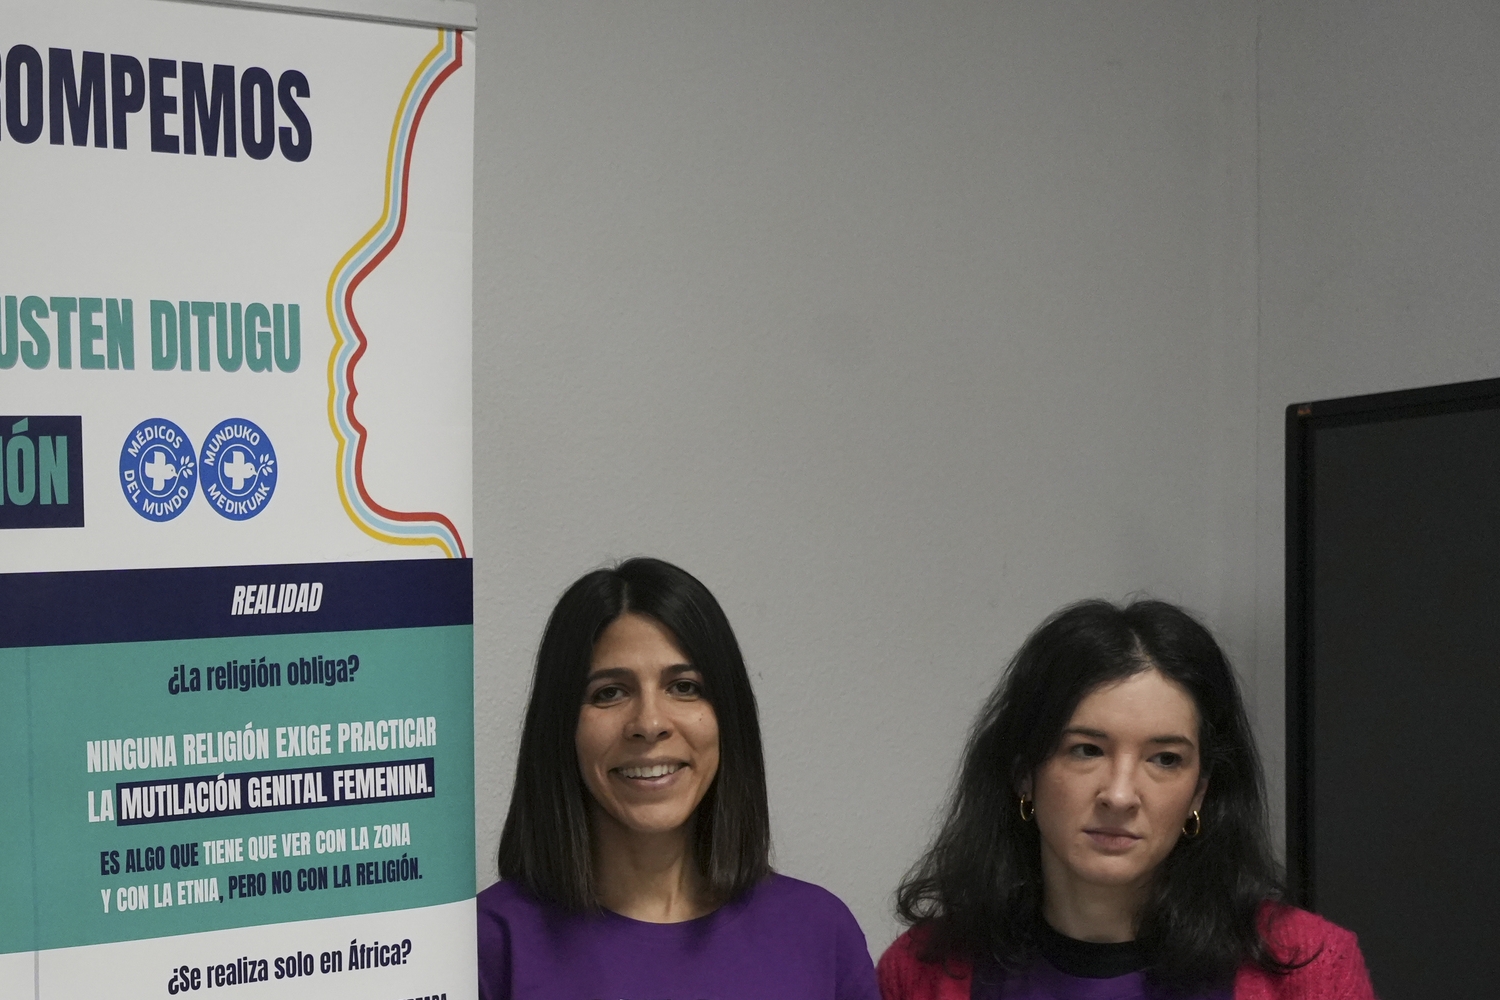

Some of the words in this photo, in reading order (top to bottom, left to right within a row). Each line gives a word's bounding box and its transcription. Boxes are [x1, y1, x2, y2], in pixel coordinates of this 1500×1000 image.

[150, 300, 301, 373] DITUGU
[128, 425, 182, 457] MÉDICOS
[204, 425, 260, 466] MUNDUKO
[124, 470, 142, 503] DEL
[143, 485, 188, 516] MUNDO
[208, 482, 270, 514] MEDIKUAK
[232, 583, 323, 616] REALIDAD
[168, 664, 200, 695] ¿La
[207, 657, 280, 691] religión
[288, 655, 359, 687] obliga?
[87, 734, 177, 772] NINGUNA
[183, 722, 269, 766] RELIGIÓN
[276, 724, 331, 758] EXIGE
[338, 716, 436, 752] PRACTICAR
[88, 790, 114, 823] LA
[121, 773, 241, 819] MUTILACIÓN
[248, 772, 327, 808] GENITAL
[334, 763, 432, 801] FEMENINA.
[100, 851, 120, 875] ES
[126, 846, 164, 873] ALGO
[170, 843, 198, 869] QUE
[203, 838, 243, 866] TIENE
[248, 835, 277, 862] QUE
[282, 833, 310, 857] VER
[315, 829, 346, 855] CON
[351, 827, 369, 851] LA
[374, 823, 410, 848] ZONA
[101, 889, 110, 913] Y
[117, 885, 148, 912] CON
[154, 883, 173, 908] LA
[177, 877, 224, 904] ETNIA,
[228, 873, 266, 899] PERO
[272, 870, 292, 894] NO
[298, 868, 328, 892] CON
[333, 865, 351, 888] LA
[356, 853, 422, 886] RELIGIÓN.
[168, 964, 201, 995] ¿Se
[207, 957, 268, 988] realiza
[274, 951, 315, 979] solo
[320, 952, 343, 973] en
[348, 939, 412, 971] África?
